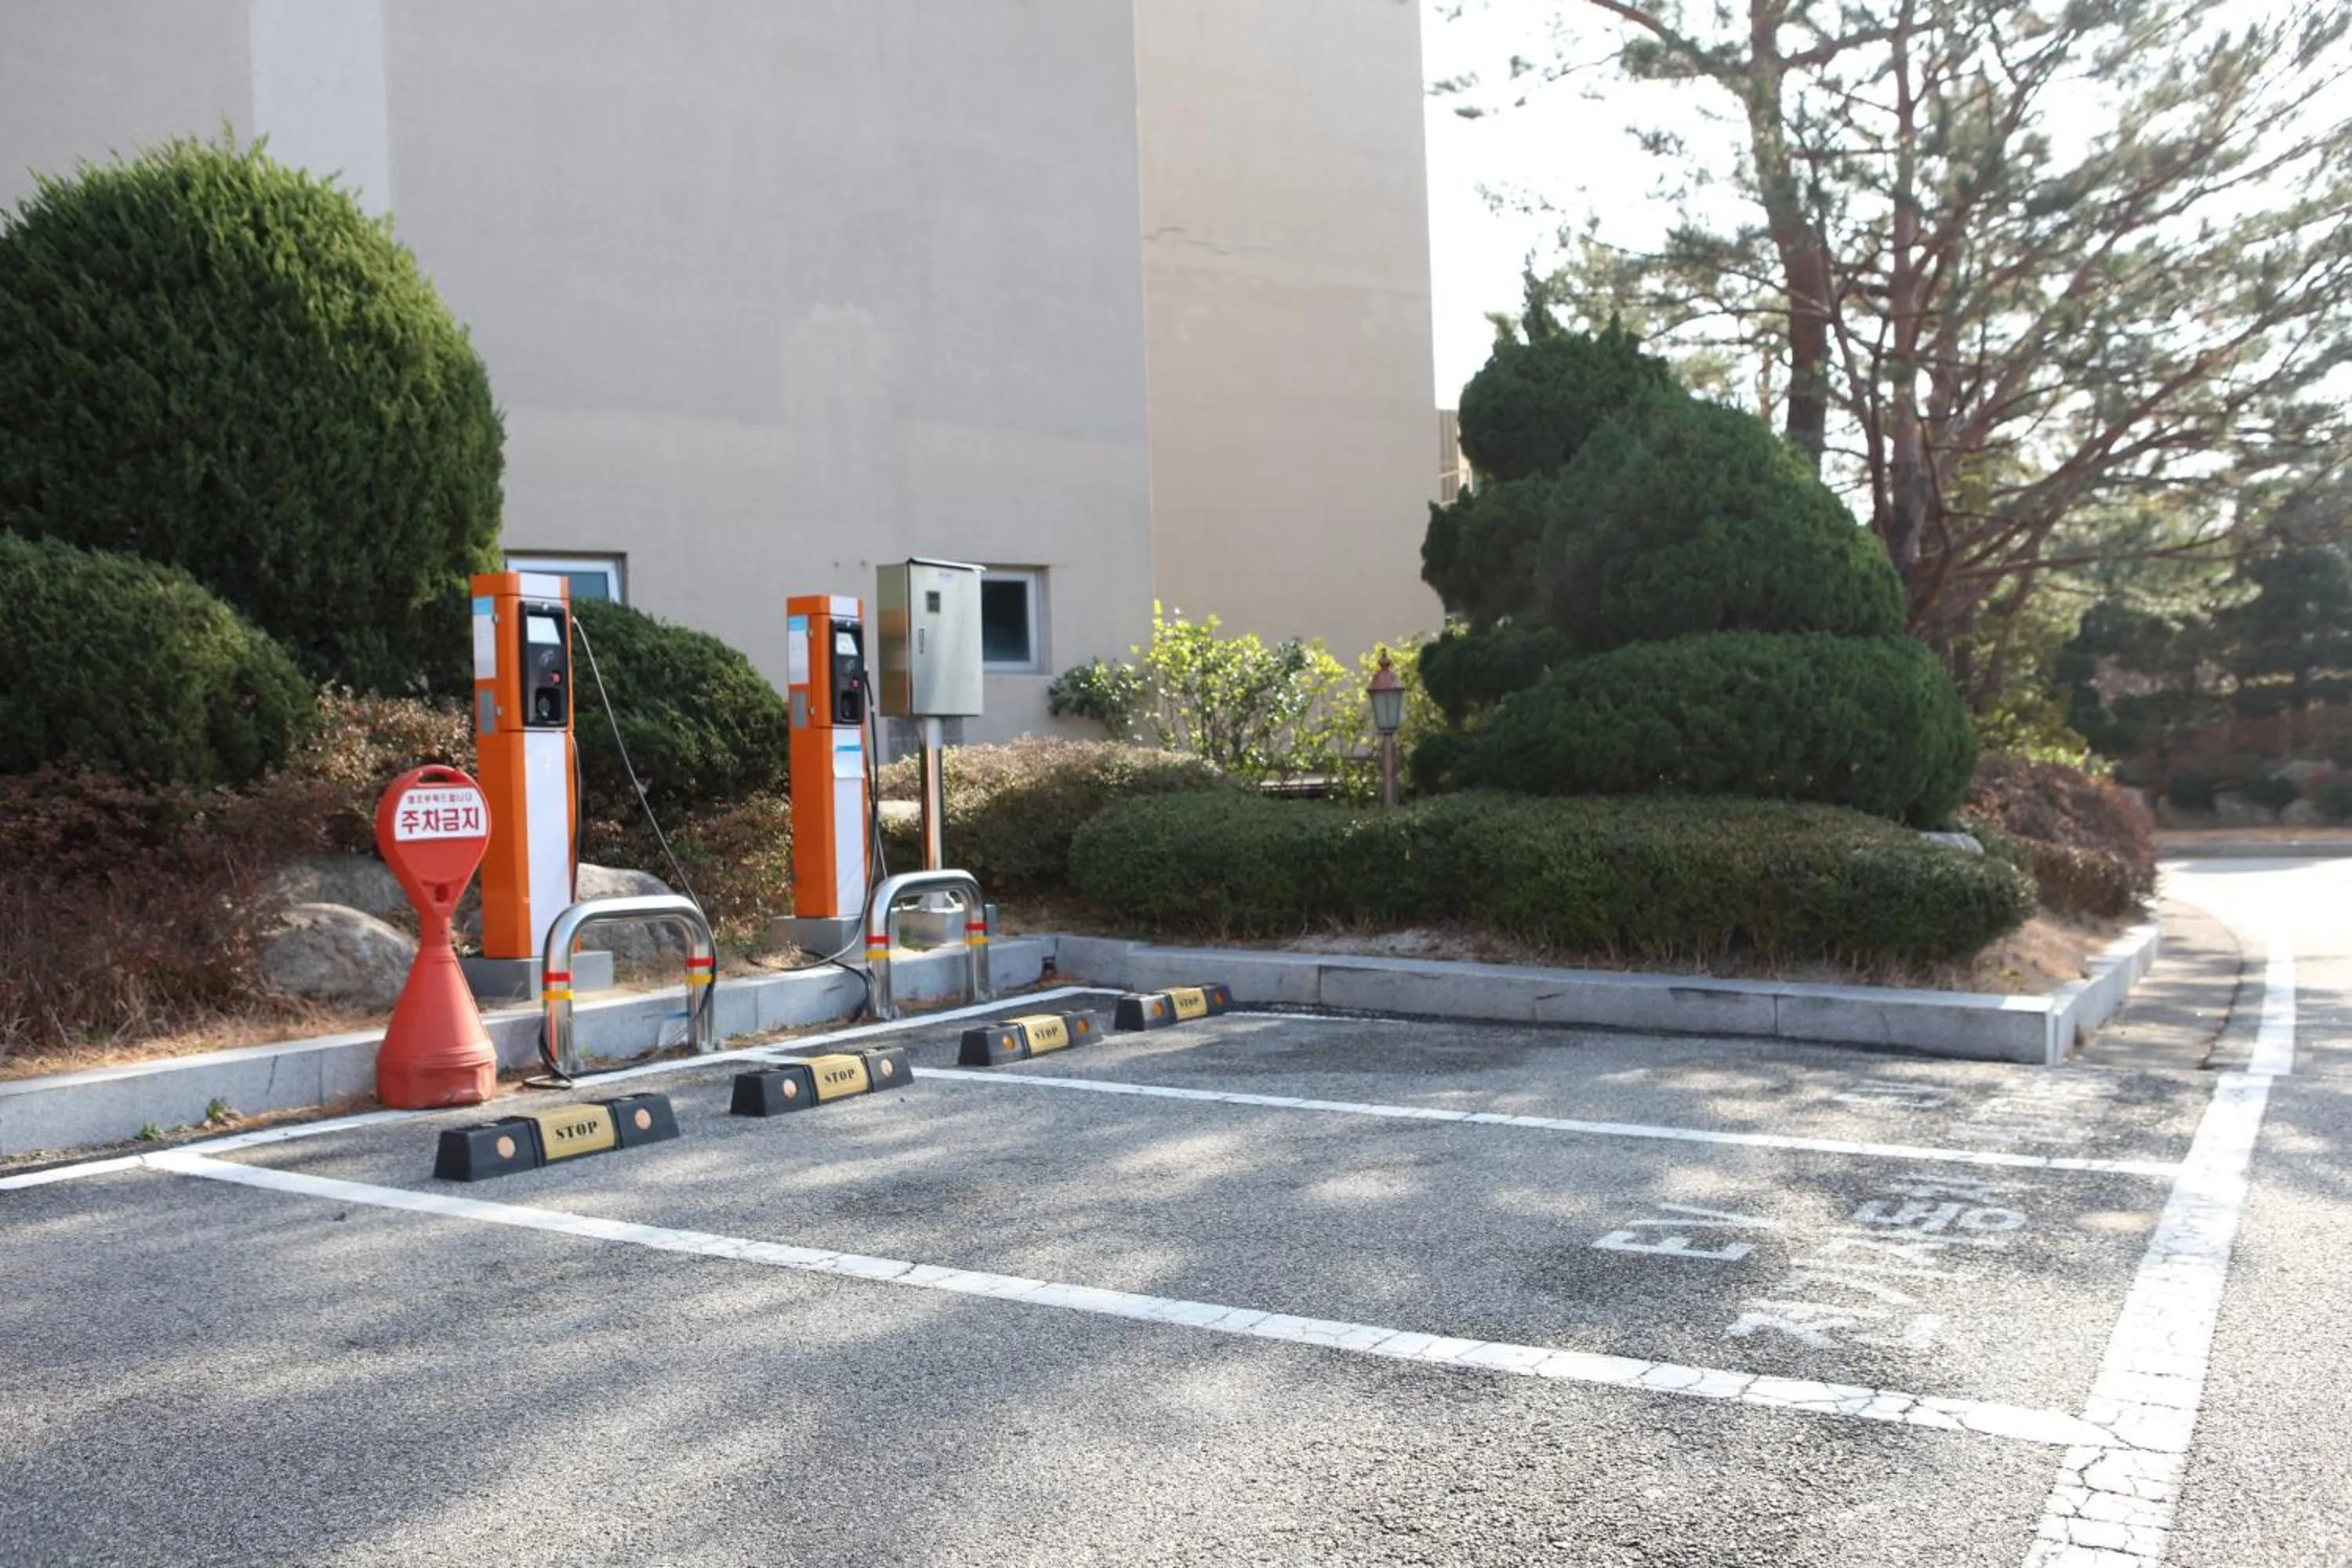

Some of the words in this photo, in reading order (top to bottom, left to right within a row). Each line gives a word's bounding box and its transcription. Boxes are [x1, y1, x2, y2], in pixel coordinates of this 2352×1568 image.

[401, 806, 479, 833] 주차금지
[1178, 996, 1199, 1007] STOP
[1034, 1026, 1058, 1039] STOP
[824, 1069, 855, 1083] STOP
[555, 1120, 597, 1140] STOP
[1592, 1202, 1780, 1261] EV
